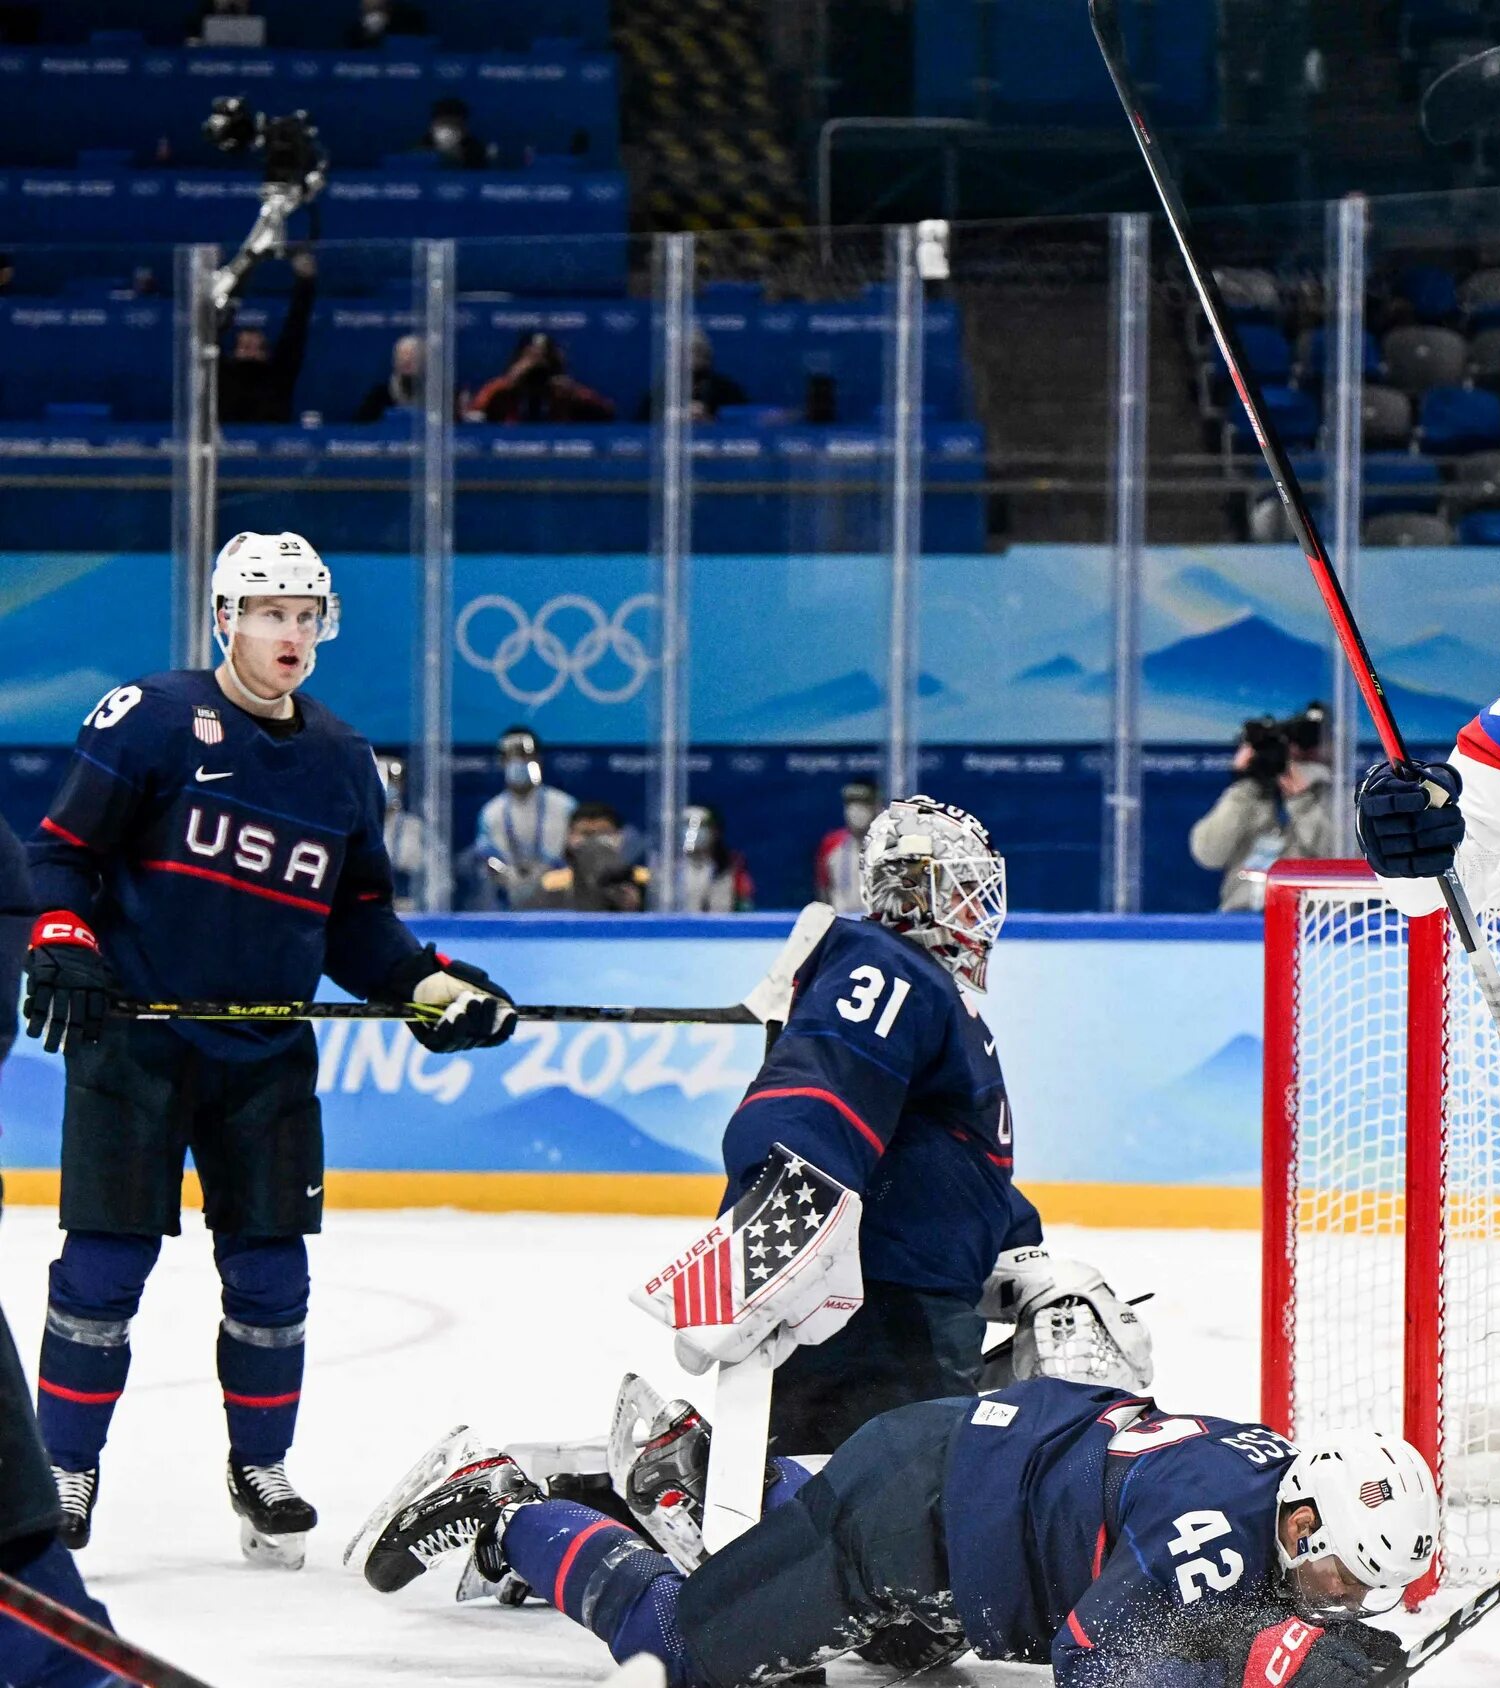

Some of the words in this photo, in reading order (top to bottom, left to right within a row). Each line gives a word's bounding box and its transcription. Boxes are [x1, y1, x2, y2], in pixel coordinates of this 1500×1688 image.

[197, 707, 216, 718] USA
[186, 808, 329, 888] USA
[228, 1004, 292, 1016] SUPER
[836, 964, 911, 1039] 31
[501, 1020, 757, 1100] 2022
[644, 1226, 724, 1296] BAUER
[822, 1300, 858, 1312] MACH
[1380, 1482, 1391, 1500] USA
[1167, 1510, 1245, 1605] 42
[1410, 1534, 1434, 1561] 42
